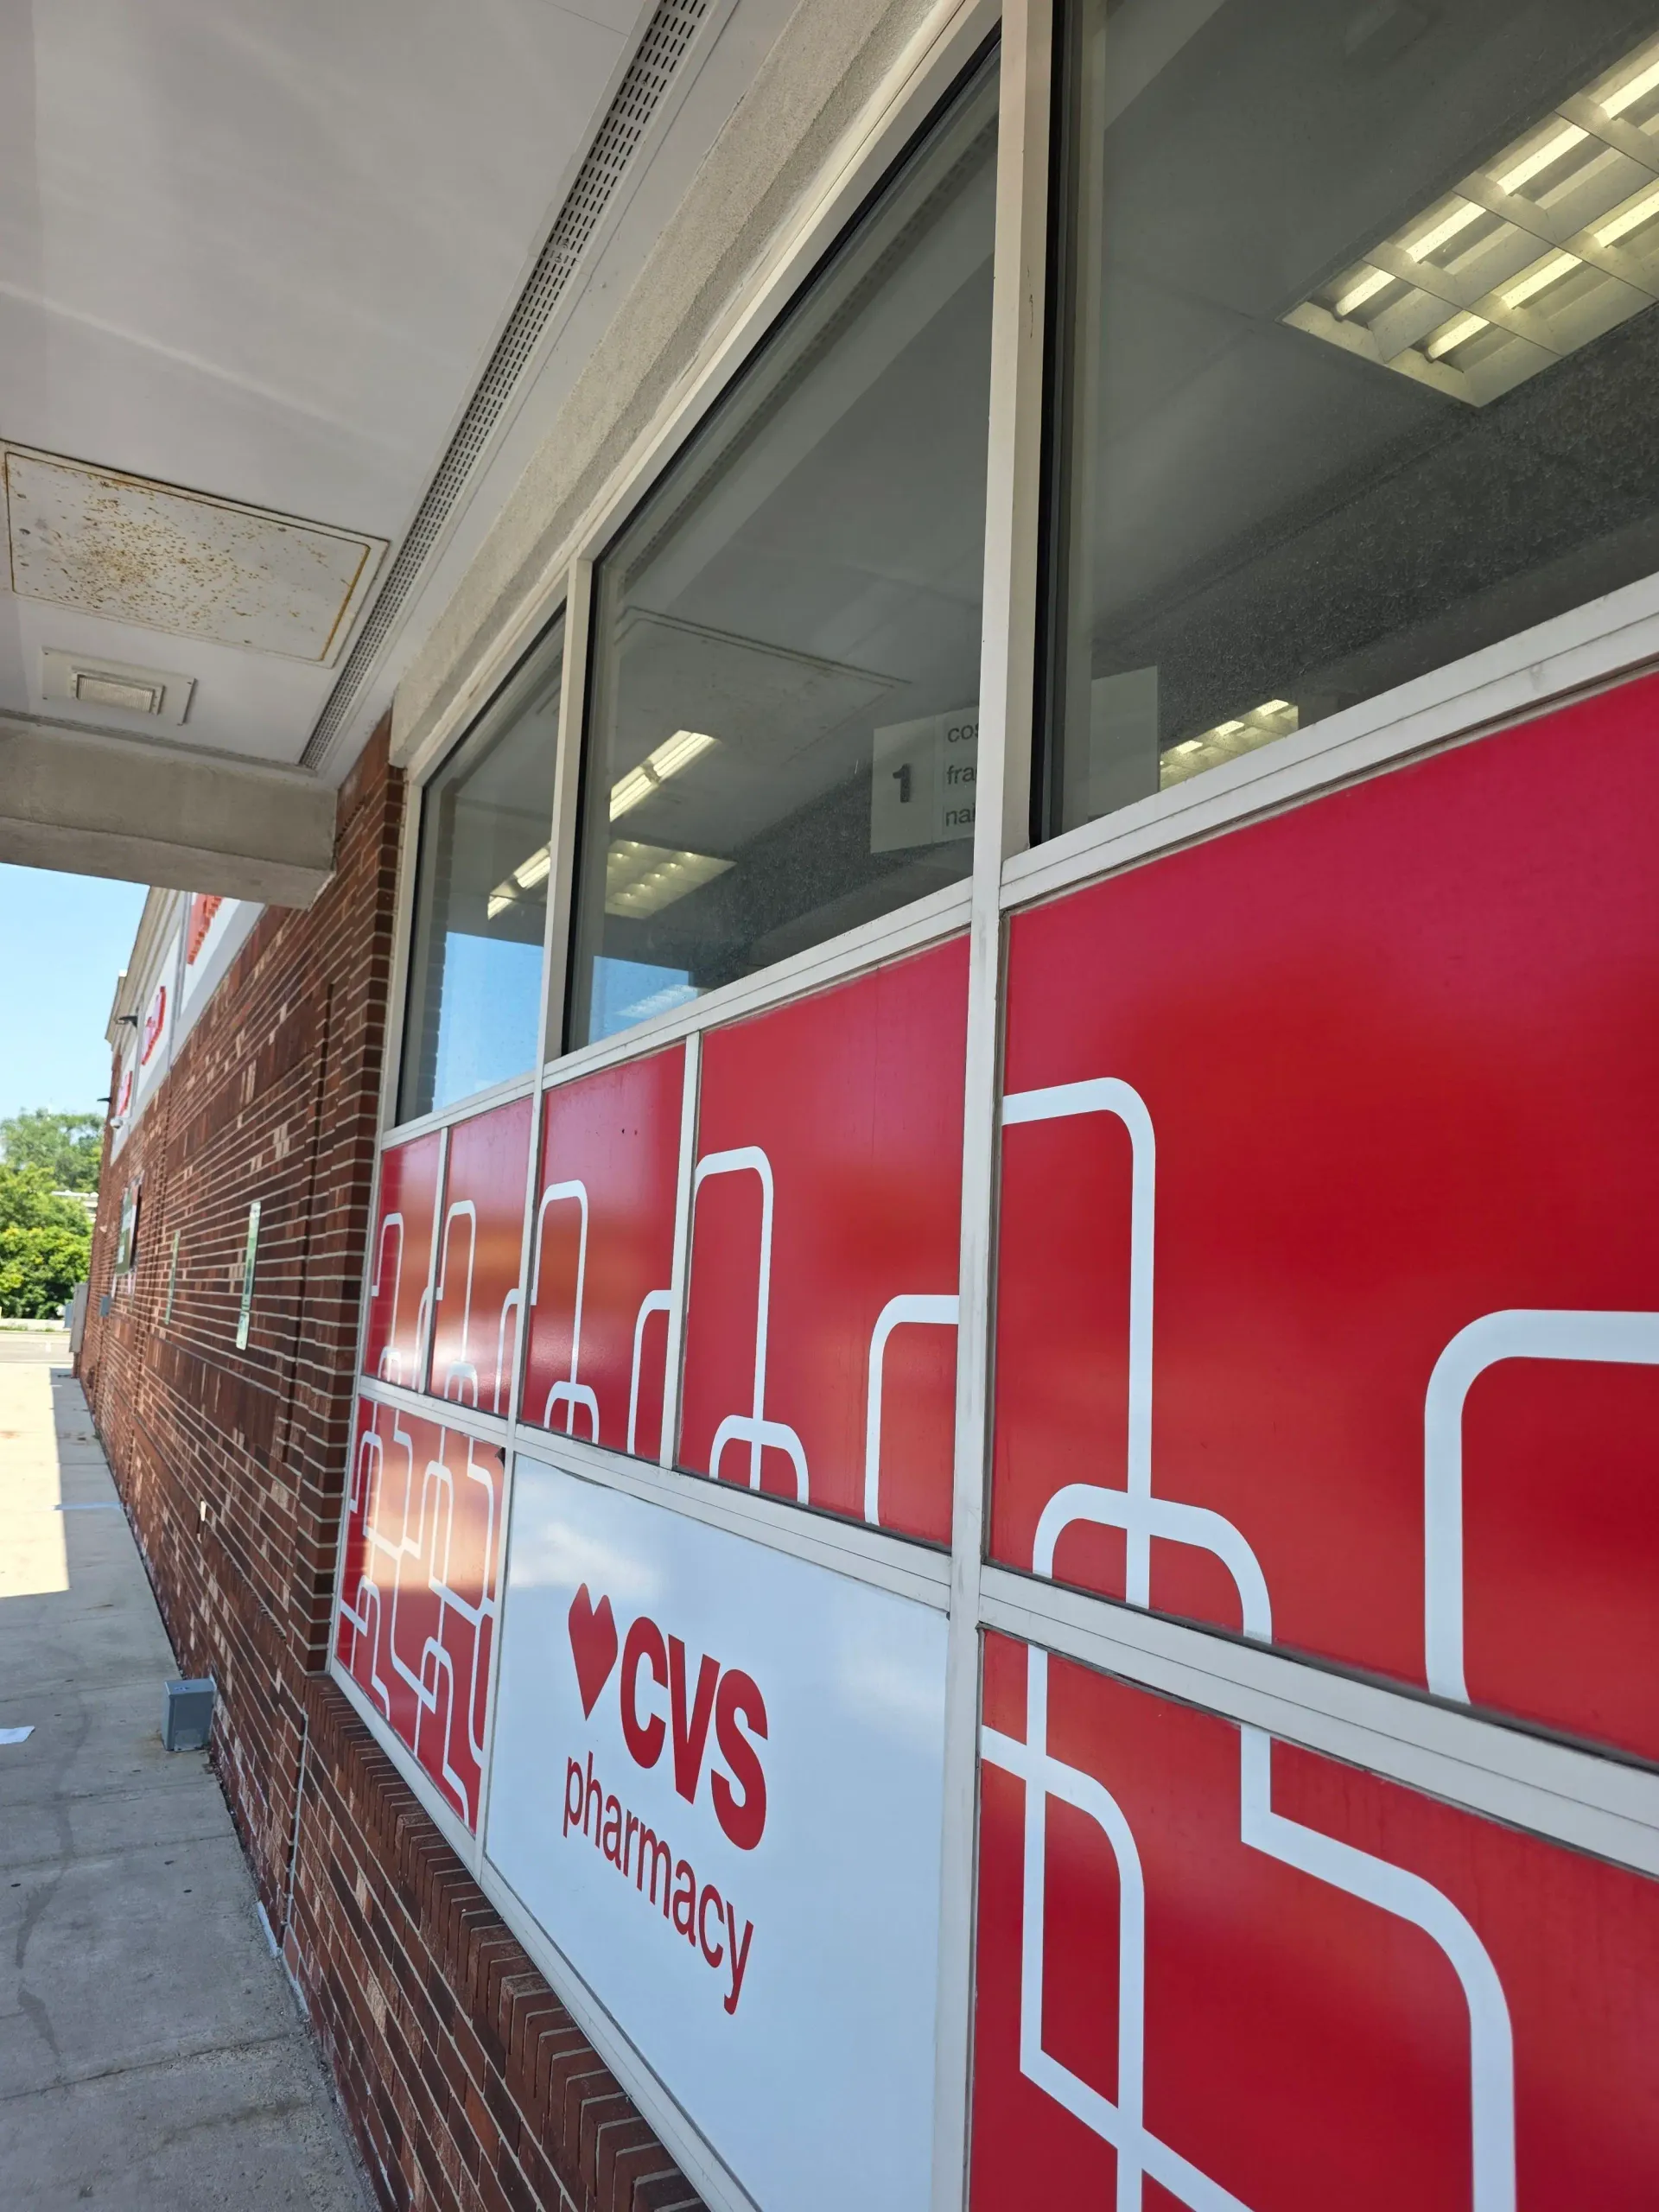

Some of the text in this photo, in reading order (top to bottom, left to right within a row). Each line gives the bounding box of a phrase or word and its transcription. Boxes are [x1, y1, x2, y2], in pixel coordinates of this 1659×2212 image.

[892, 764, 912, 803] 1
[946, 765, 977, 785] fra
[620, 1616, 768, 1851] CVS
[563, 1751, 753, 2015] pharmacy
